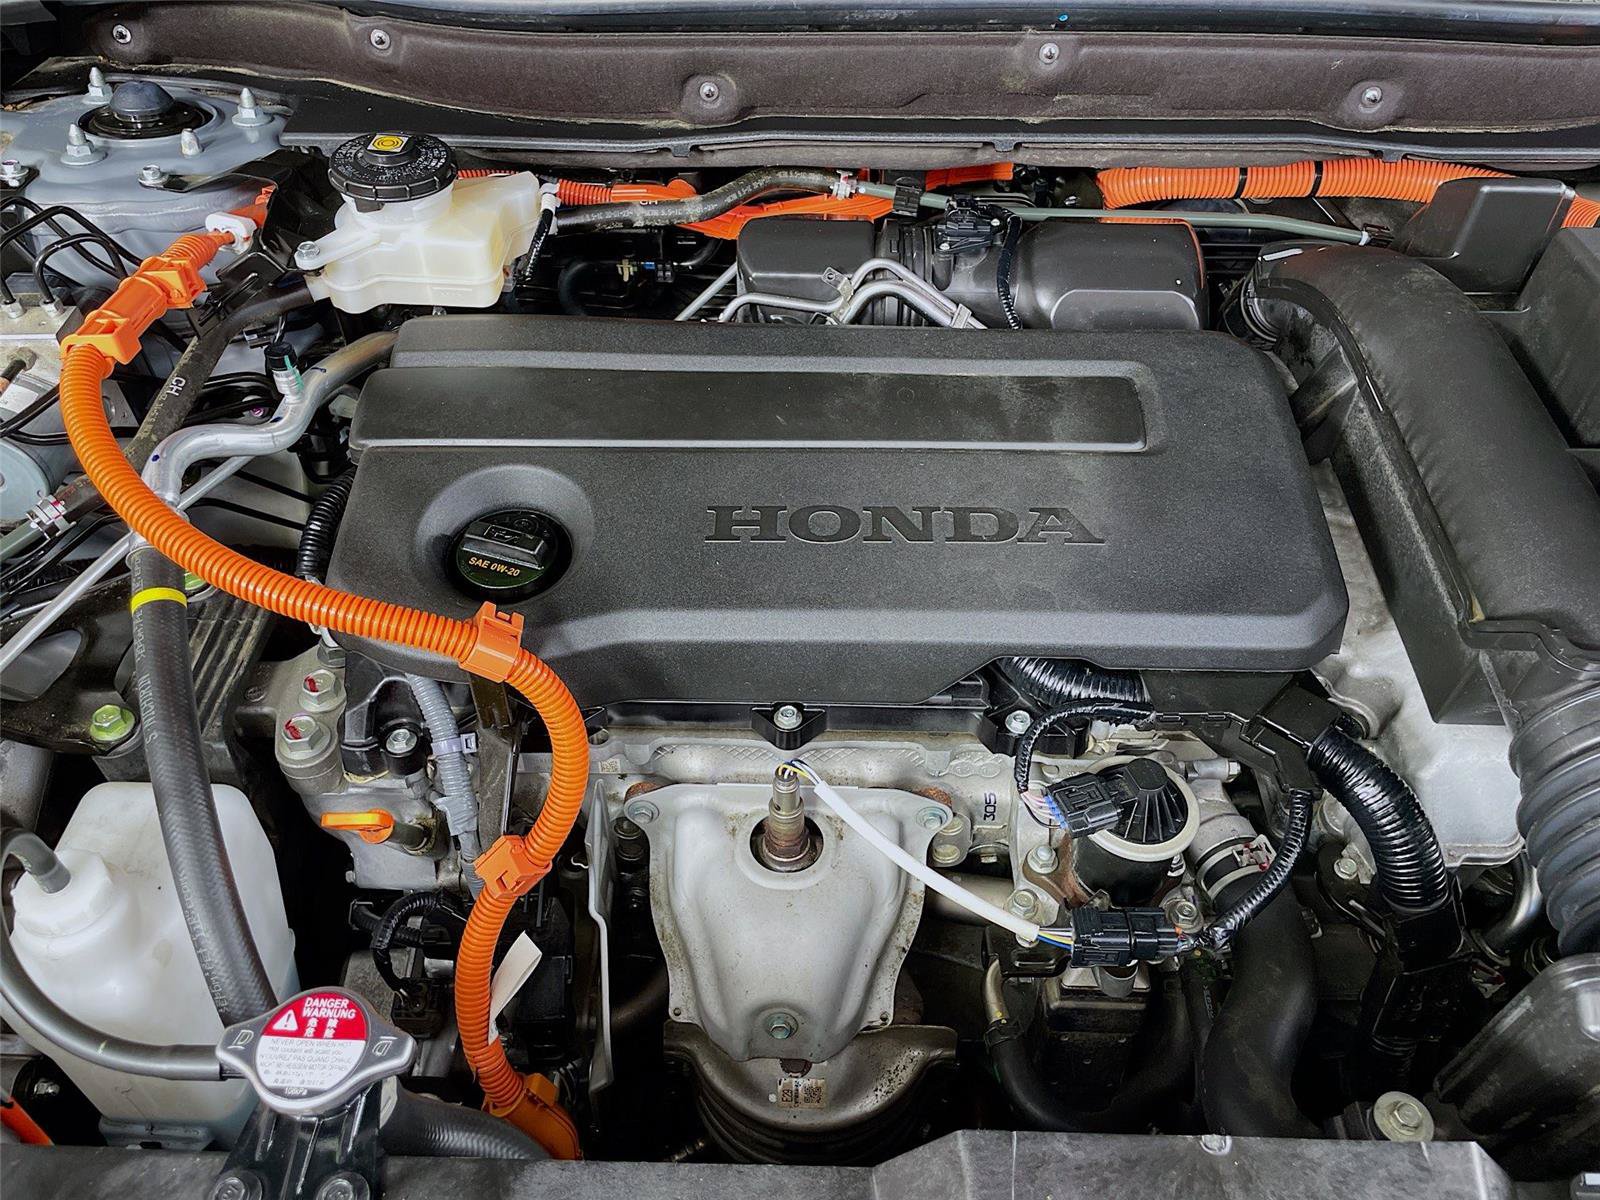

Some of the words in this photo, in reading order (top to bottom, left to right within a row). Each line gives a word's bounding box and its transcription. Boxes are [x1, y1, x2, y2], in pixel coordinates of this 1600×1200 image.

[166, 376, 186, 396] CH
[704, 505, 1106, 546] HONDA
[468, 556, 491, 569] SAE
[490, 562, 521, 577] 0W-20
[983, 792, 997, 822] 305
[305, 997, 350, 1008] DANGER
[302, 1007, 356, 1019] WARNUNG
